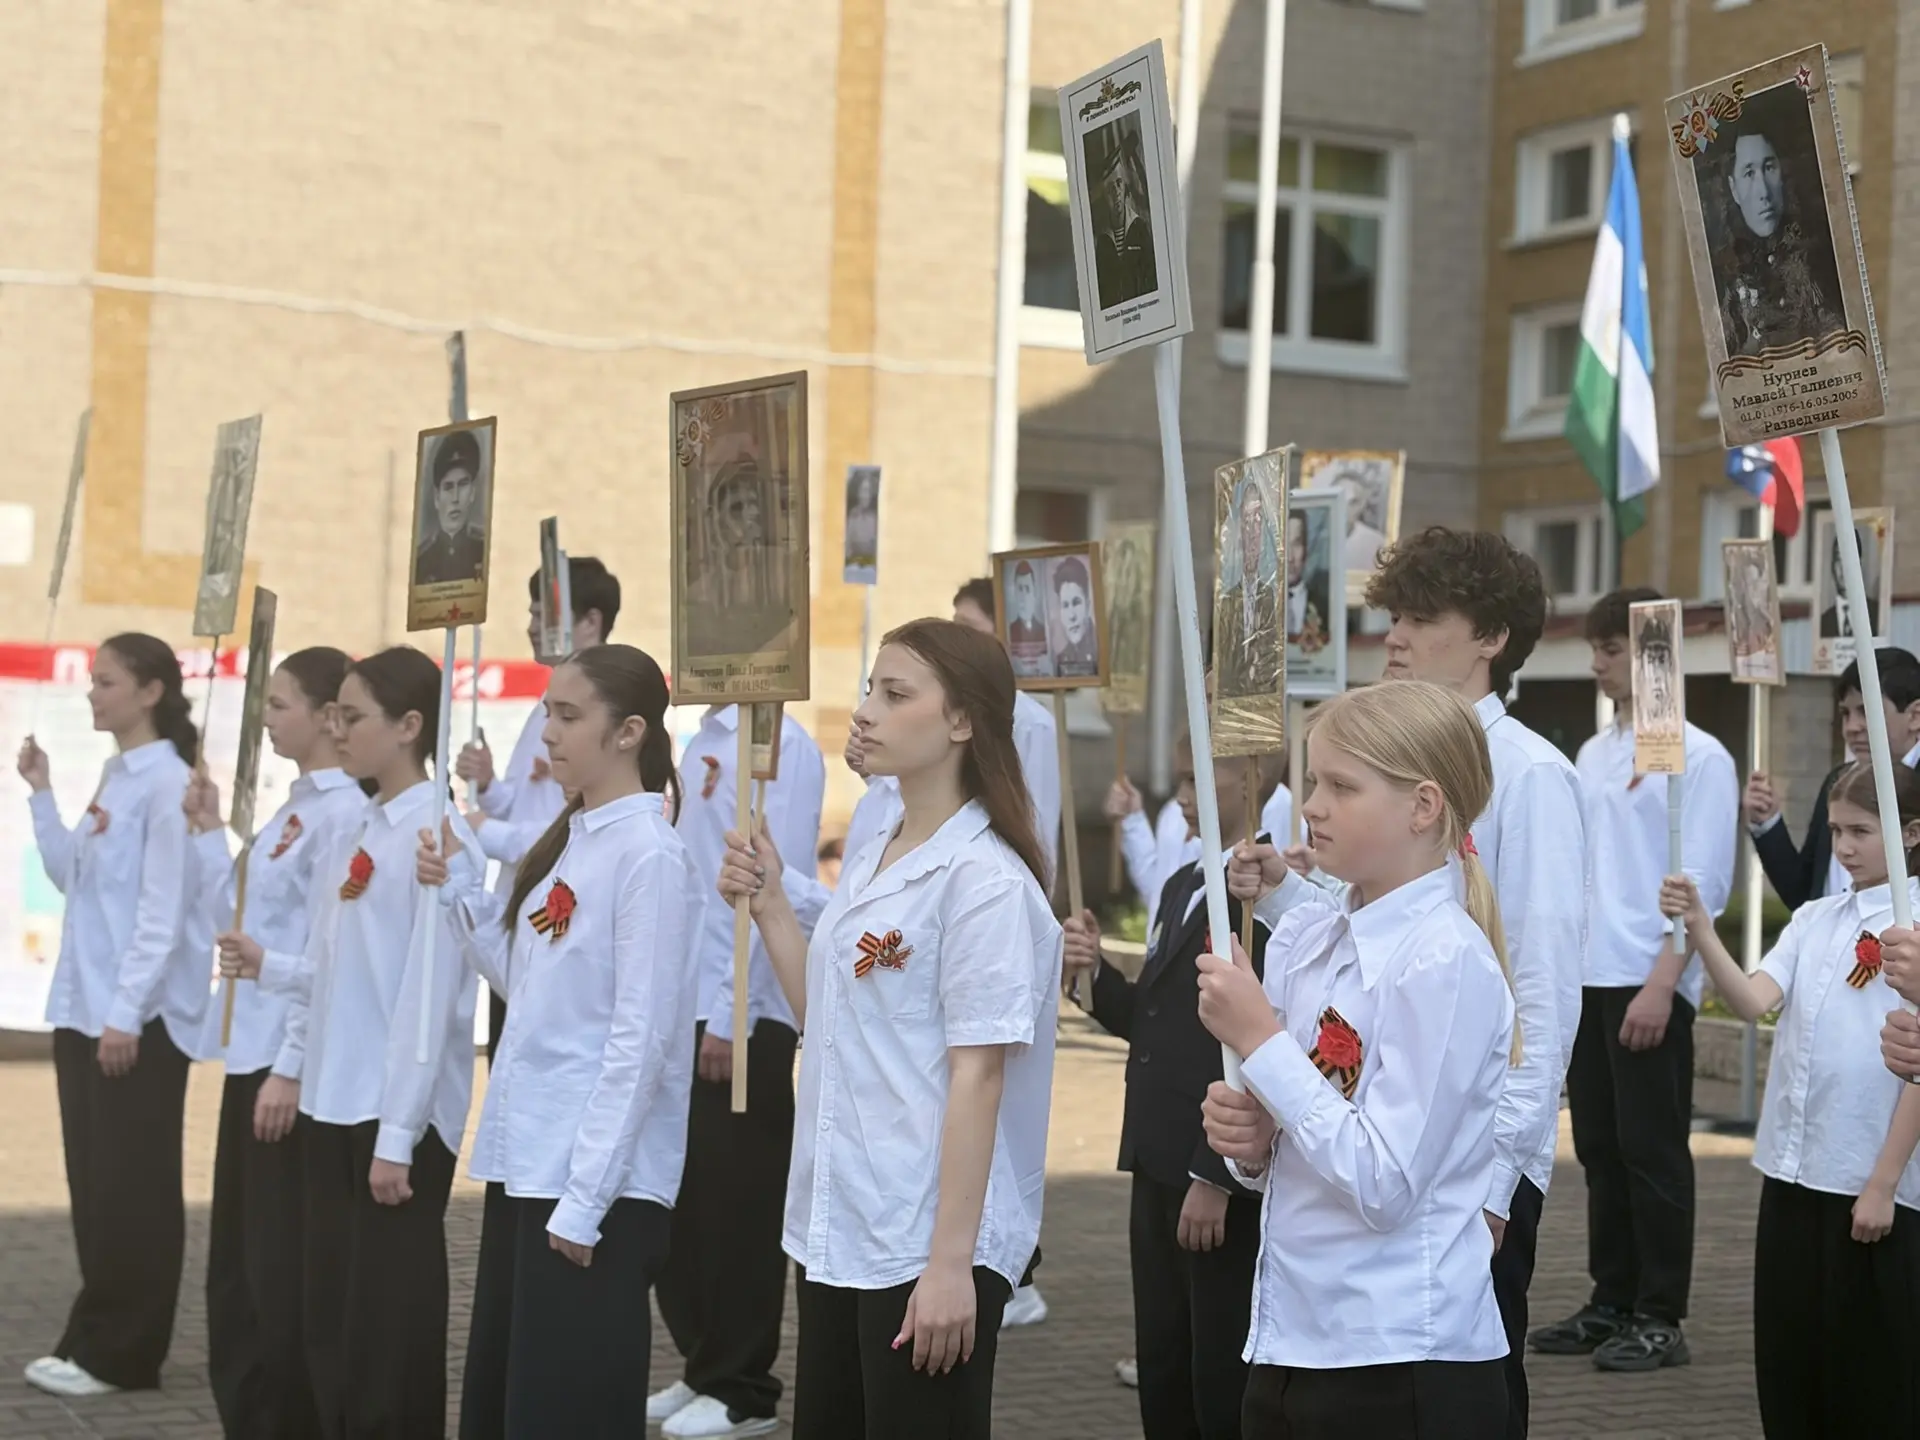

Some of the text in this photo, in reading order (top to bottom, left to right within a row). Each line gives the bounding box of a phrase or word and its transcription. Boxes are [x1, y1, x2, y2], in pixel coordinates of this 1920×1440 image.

[1762, 366, 1818, 387] Нуриев
[1732, 371, 1863, 409] Мавлей Галиевич
[1763, 409, 1840, 433] Разведчик
